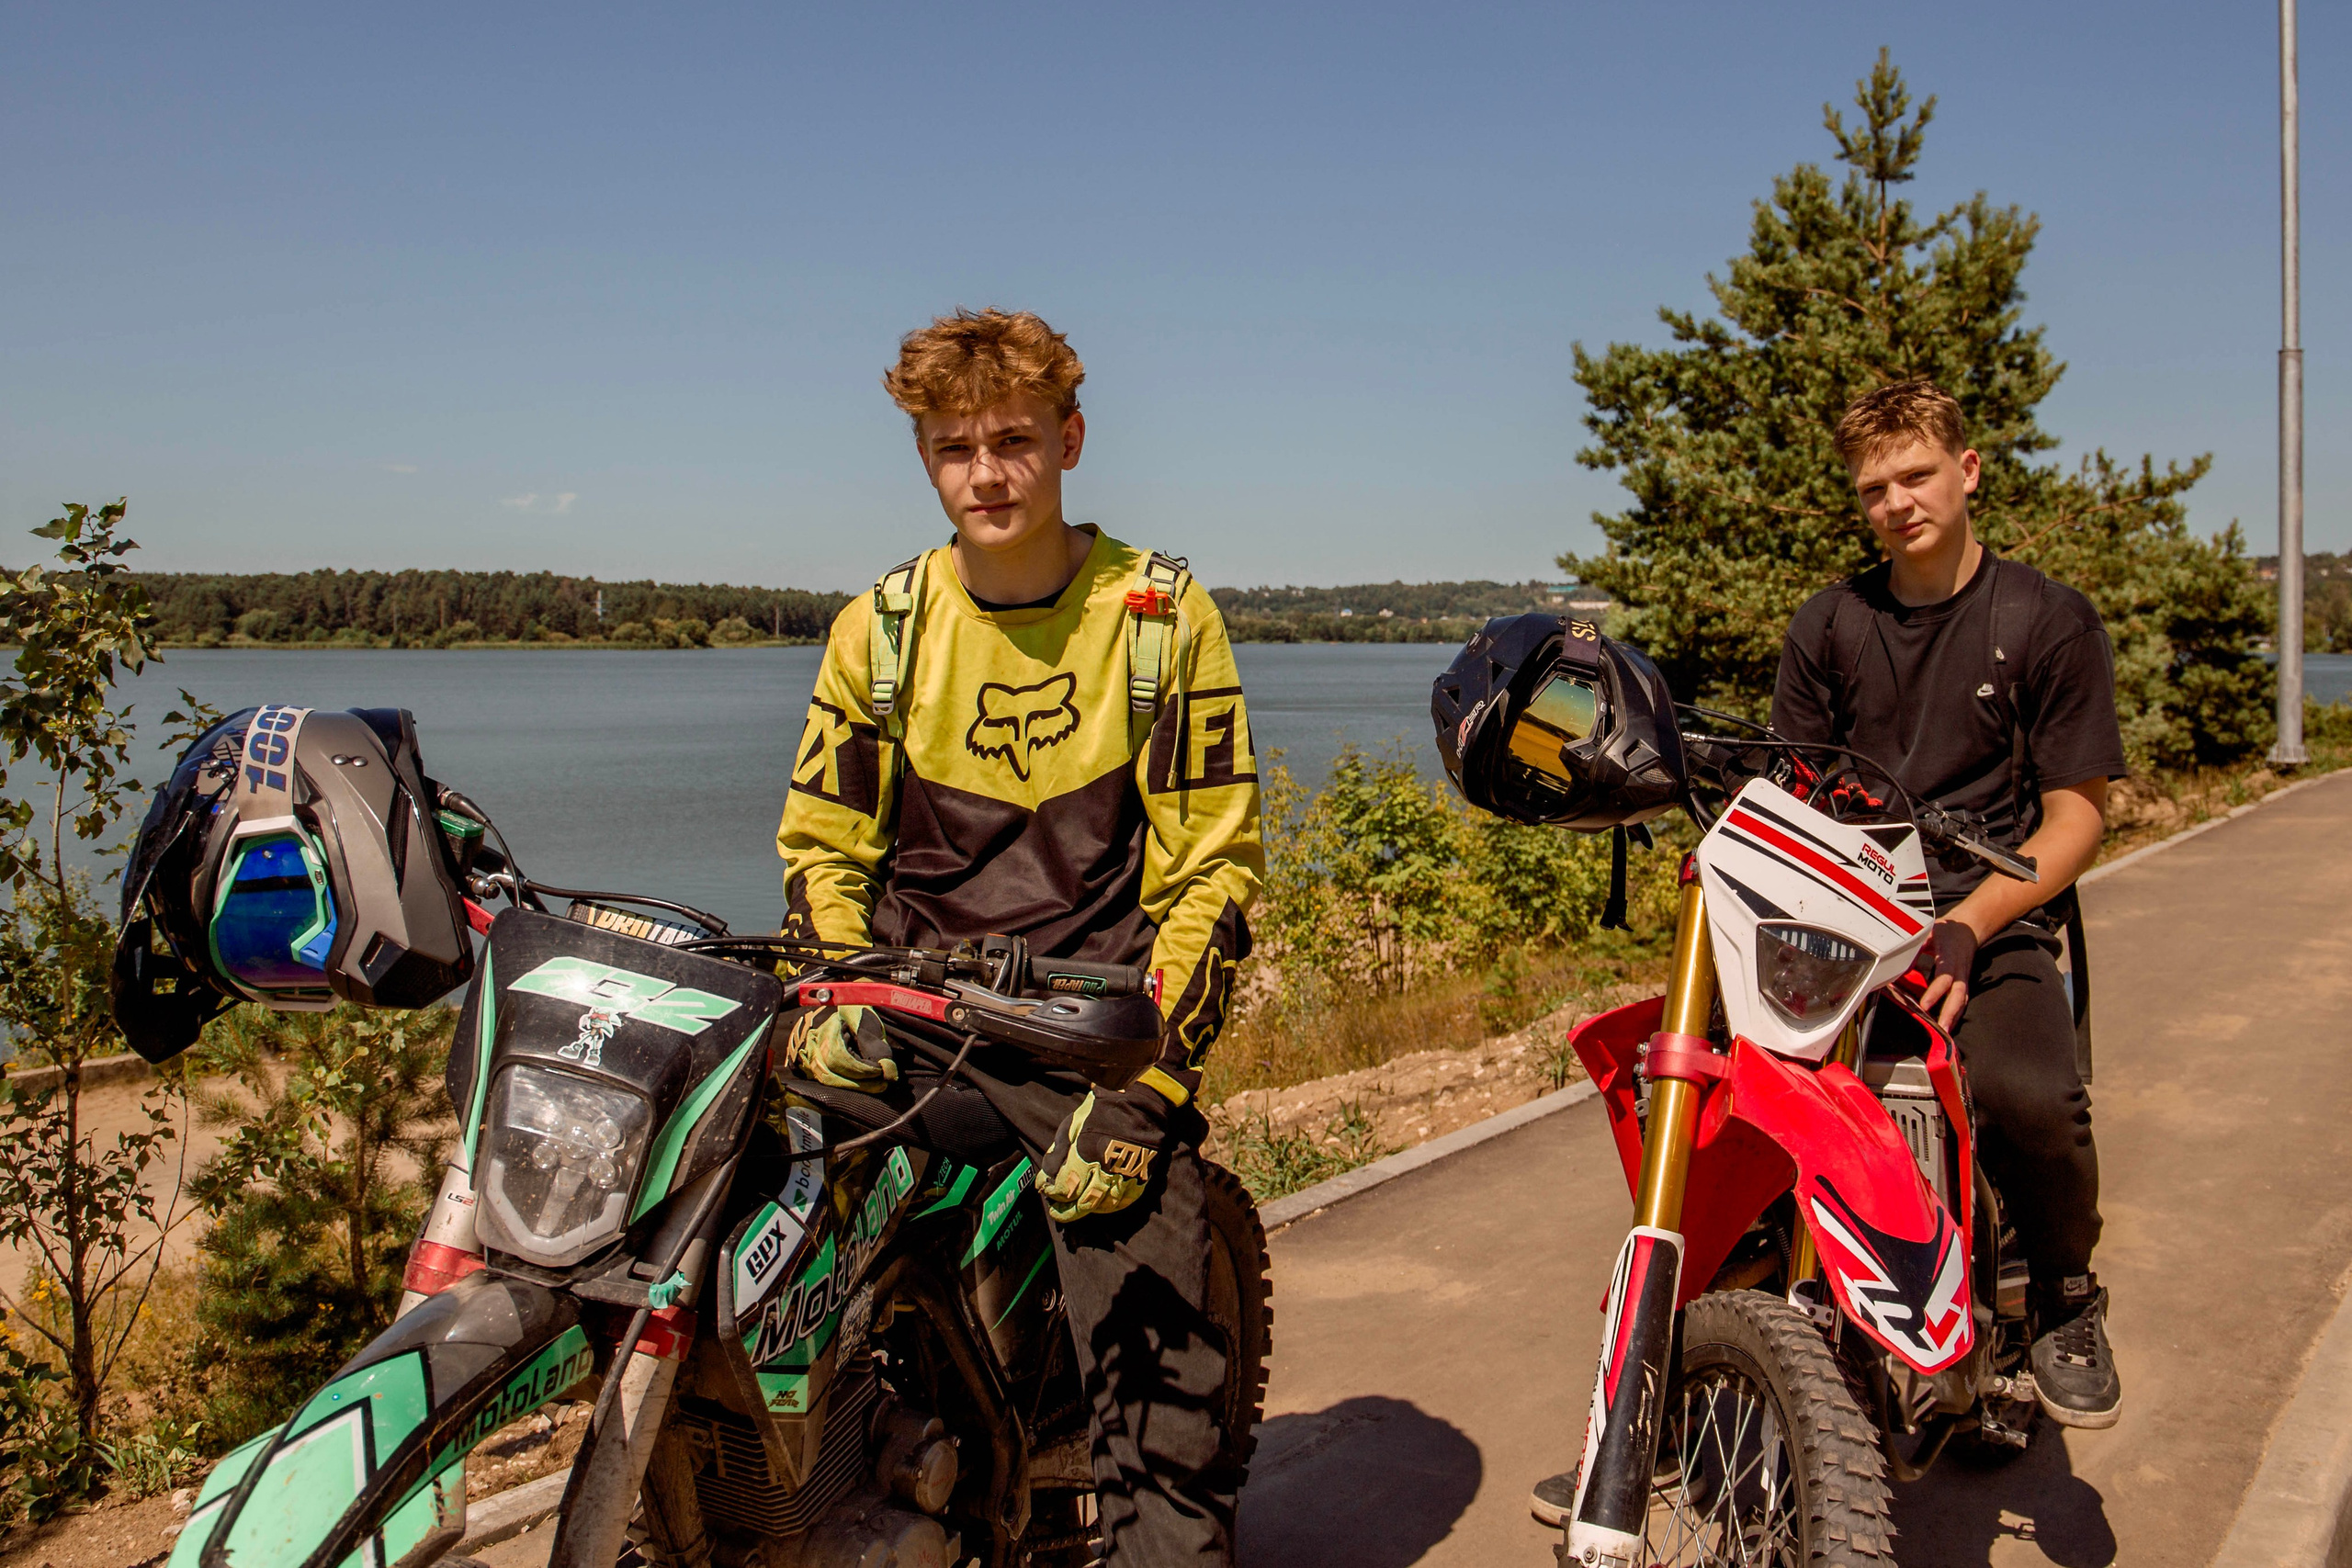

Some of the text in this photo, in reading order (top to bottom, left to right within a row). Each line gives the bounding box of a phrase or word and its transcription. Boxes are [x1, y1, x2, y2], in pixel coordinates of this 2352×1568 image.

[1857, 852, 1894, 886] MOTO
[1861, 842, 1896, 876] REGUL
[795, 1110, 812, 1190] bootmobile
[1104, 1139, 1158, 1181] FOX
[447, 1192, 474, 1207] LS2
[987, 1189, 1016, 1226] Twin Air
[996, 1211, 1023, 1251] MOTUL
[745, 1219, 787, 1285] GPX
[775, 1390, 797, 1399] NO
